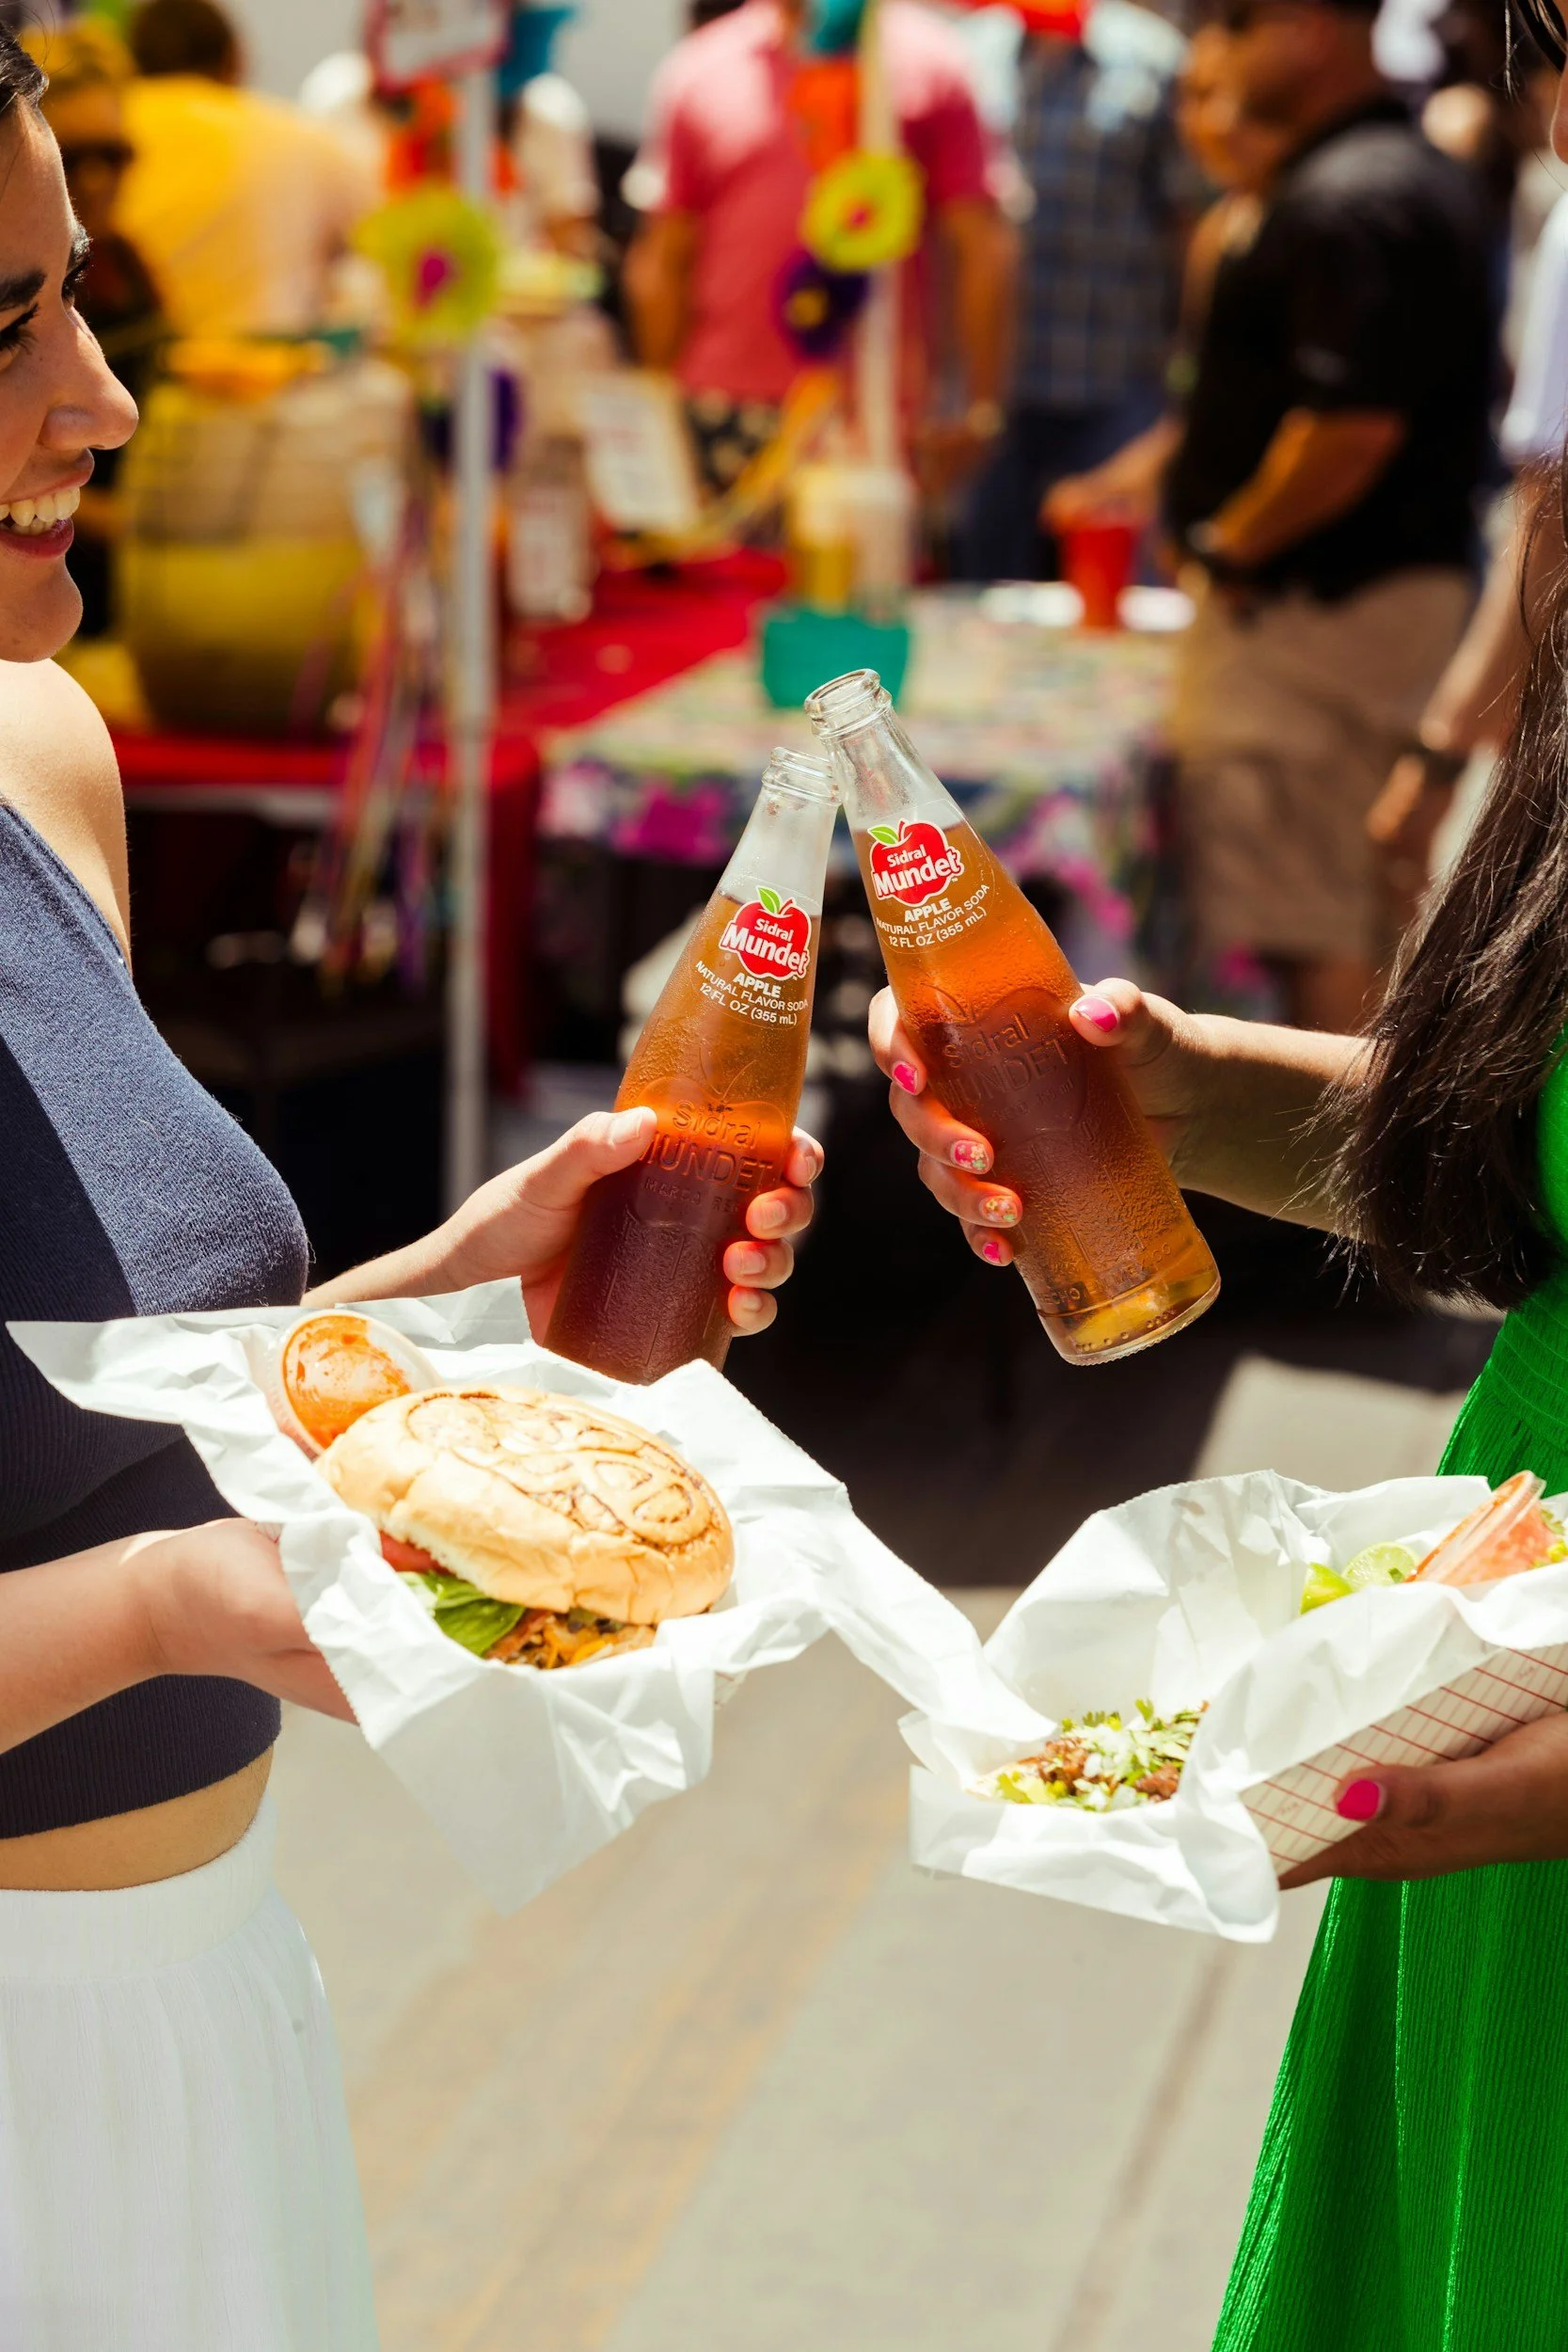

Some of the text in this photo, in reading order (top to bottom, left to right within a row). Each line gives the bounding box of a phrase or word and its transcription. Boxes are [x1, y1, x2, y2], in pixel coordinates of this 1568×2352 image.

[874, 851, 959, 897] Mundet
[887, 844, 927, 867] Sidral
[754, 918, 794, 942] Sidral
[876, 884, 990, 935] NATURAL FLAVOR SODA
[905, 898, 952, 922] APPLE
[916, 933, 935, 946] OZ
[936, 922, 963, 942] (355
[965, 906, 988, 927] mL)
[721, 924, 807, 974] Mundet
[696, 961, 808, 1011] NATURAL FLAVOR SODA
[733, 973, 781, 998] APPLE
[730, 1000, 750, 1015] OZ
[751, 1007, 777, 1023] (355
[779, 1013, 798, 1025] mL)
[943, 1013, 1029, 1068] Sidral
[673, 1100, 761, 1150] Sidral
